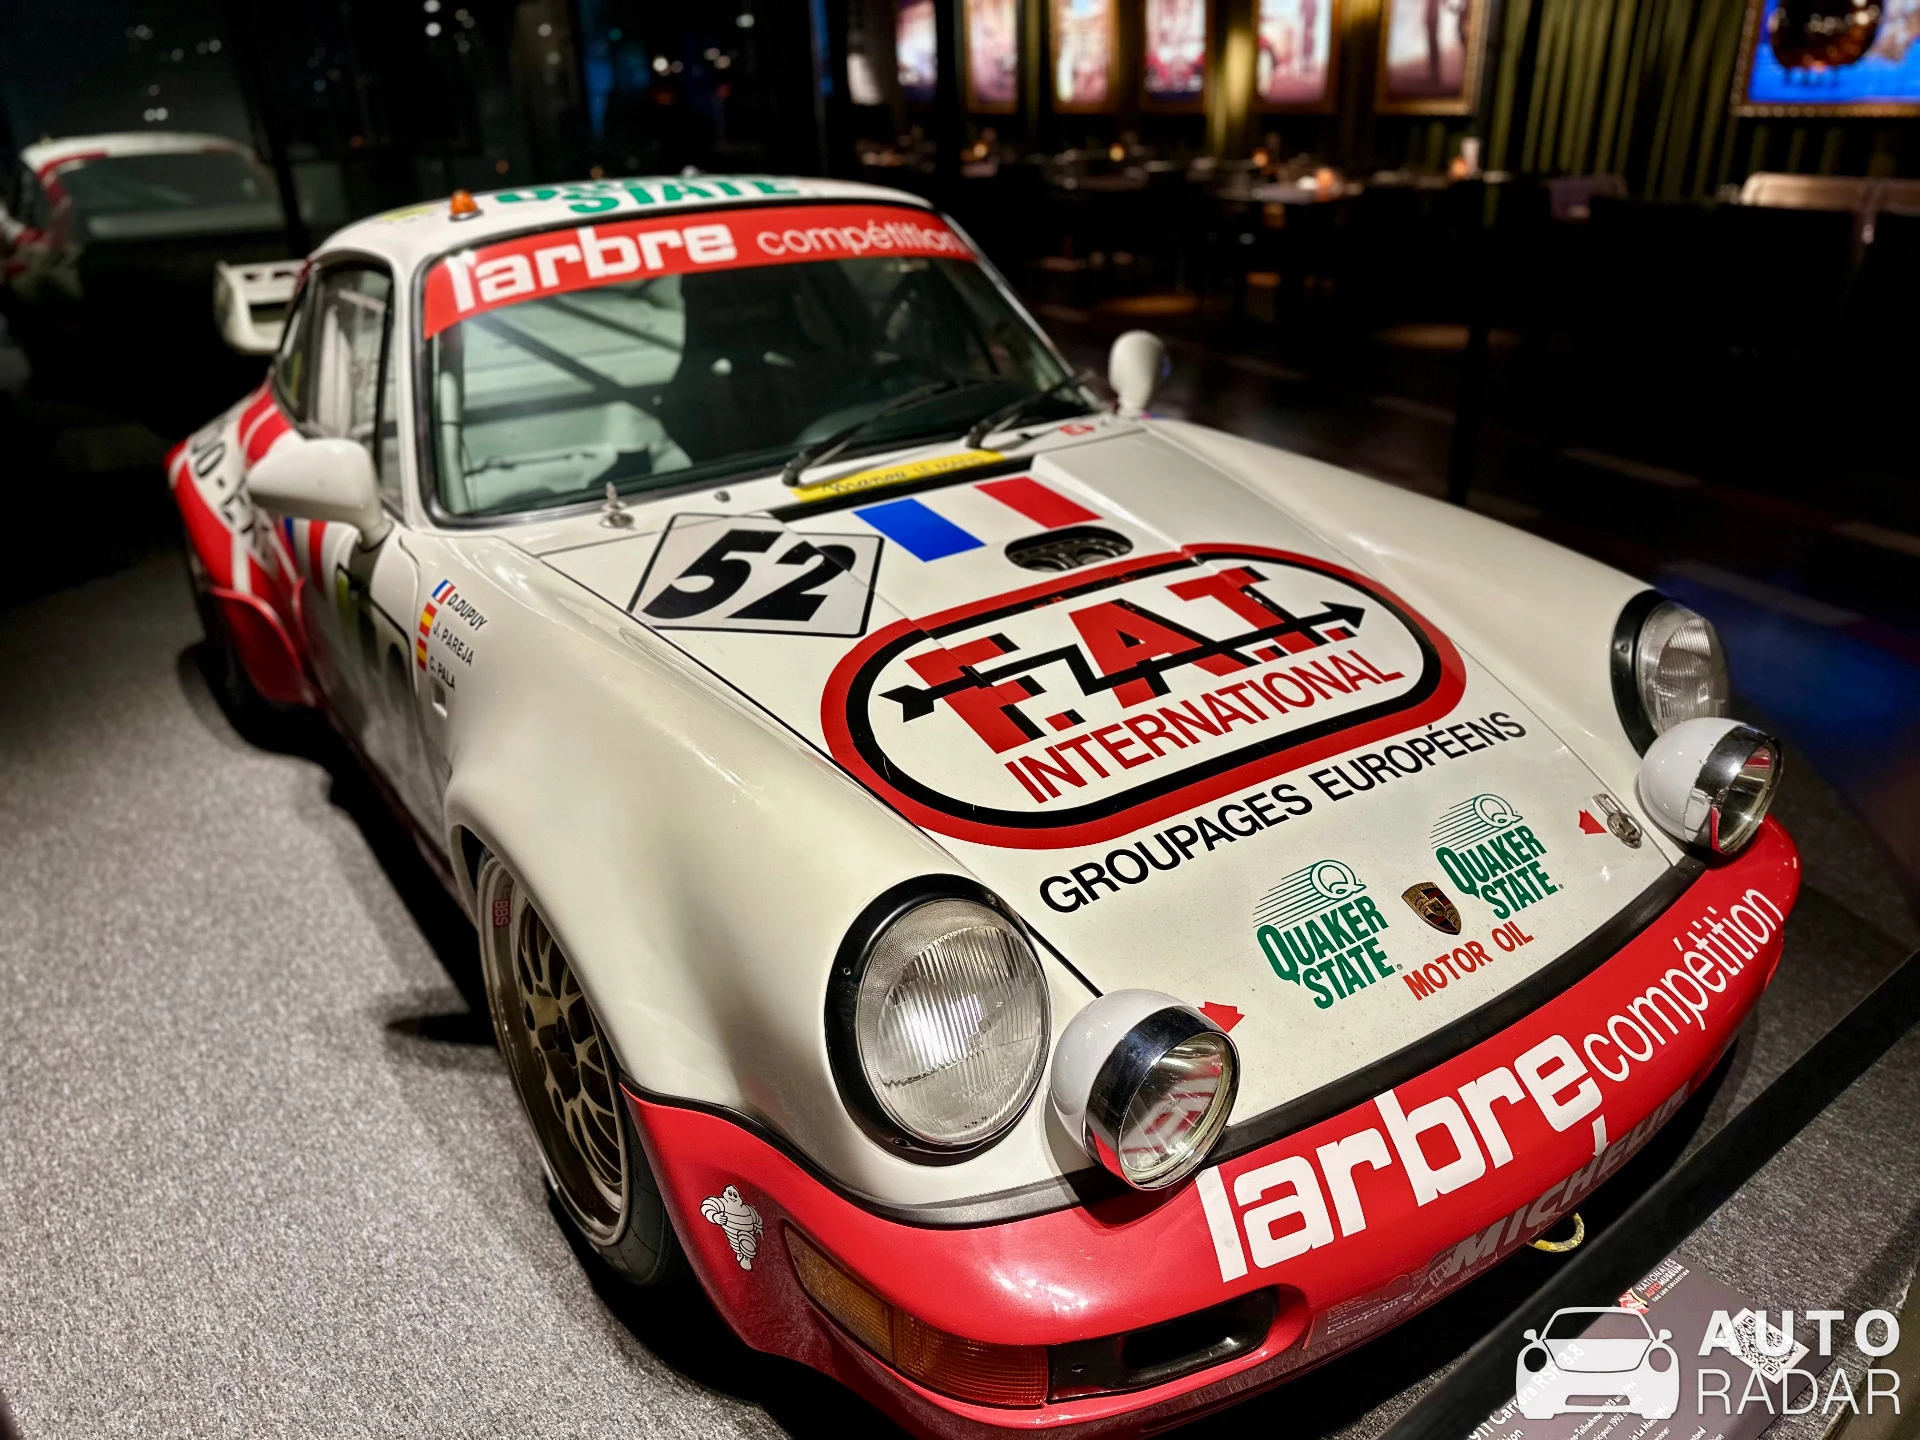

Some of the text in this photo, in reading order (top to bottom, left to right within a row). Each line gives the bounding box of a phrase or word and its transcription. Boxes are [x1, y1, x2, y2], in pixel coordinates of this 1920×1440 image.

[641, 529, 857, 622] 52
[433, 621, 474, 667] J. PAREJA
[437, 662, 455, 691] PALA
[1004, 650, 1405, 803] INTERNATIONAL
[1039, 711, 1527, 913] GROUPAGES EUROPÉENS
[1436, 825, 1548, 899] QUAKER
[1482, 861, 1560, 920] STATE
[494, 900, 510, 926] BBS
[1257, 896, 1390, 986] QUAKER
[1302, 937, 1396, 1010] STATE
[1402, 921, 1535, 1001] MOTOR OIL
[1195, 888, 1784, 1283] larbre compétition
[1445, 1081, 1689, 1279] MICHELIN
[1636, 1258, 1676, 1292] NATIONALES
[1644, 1264, 1685, 1298] AUTOMUSEUM
